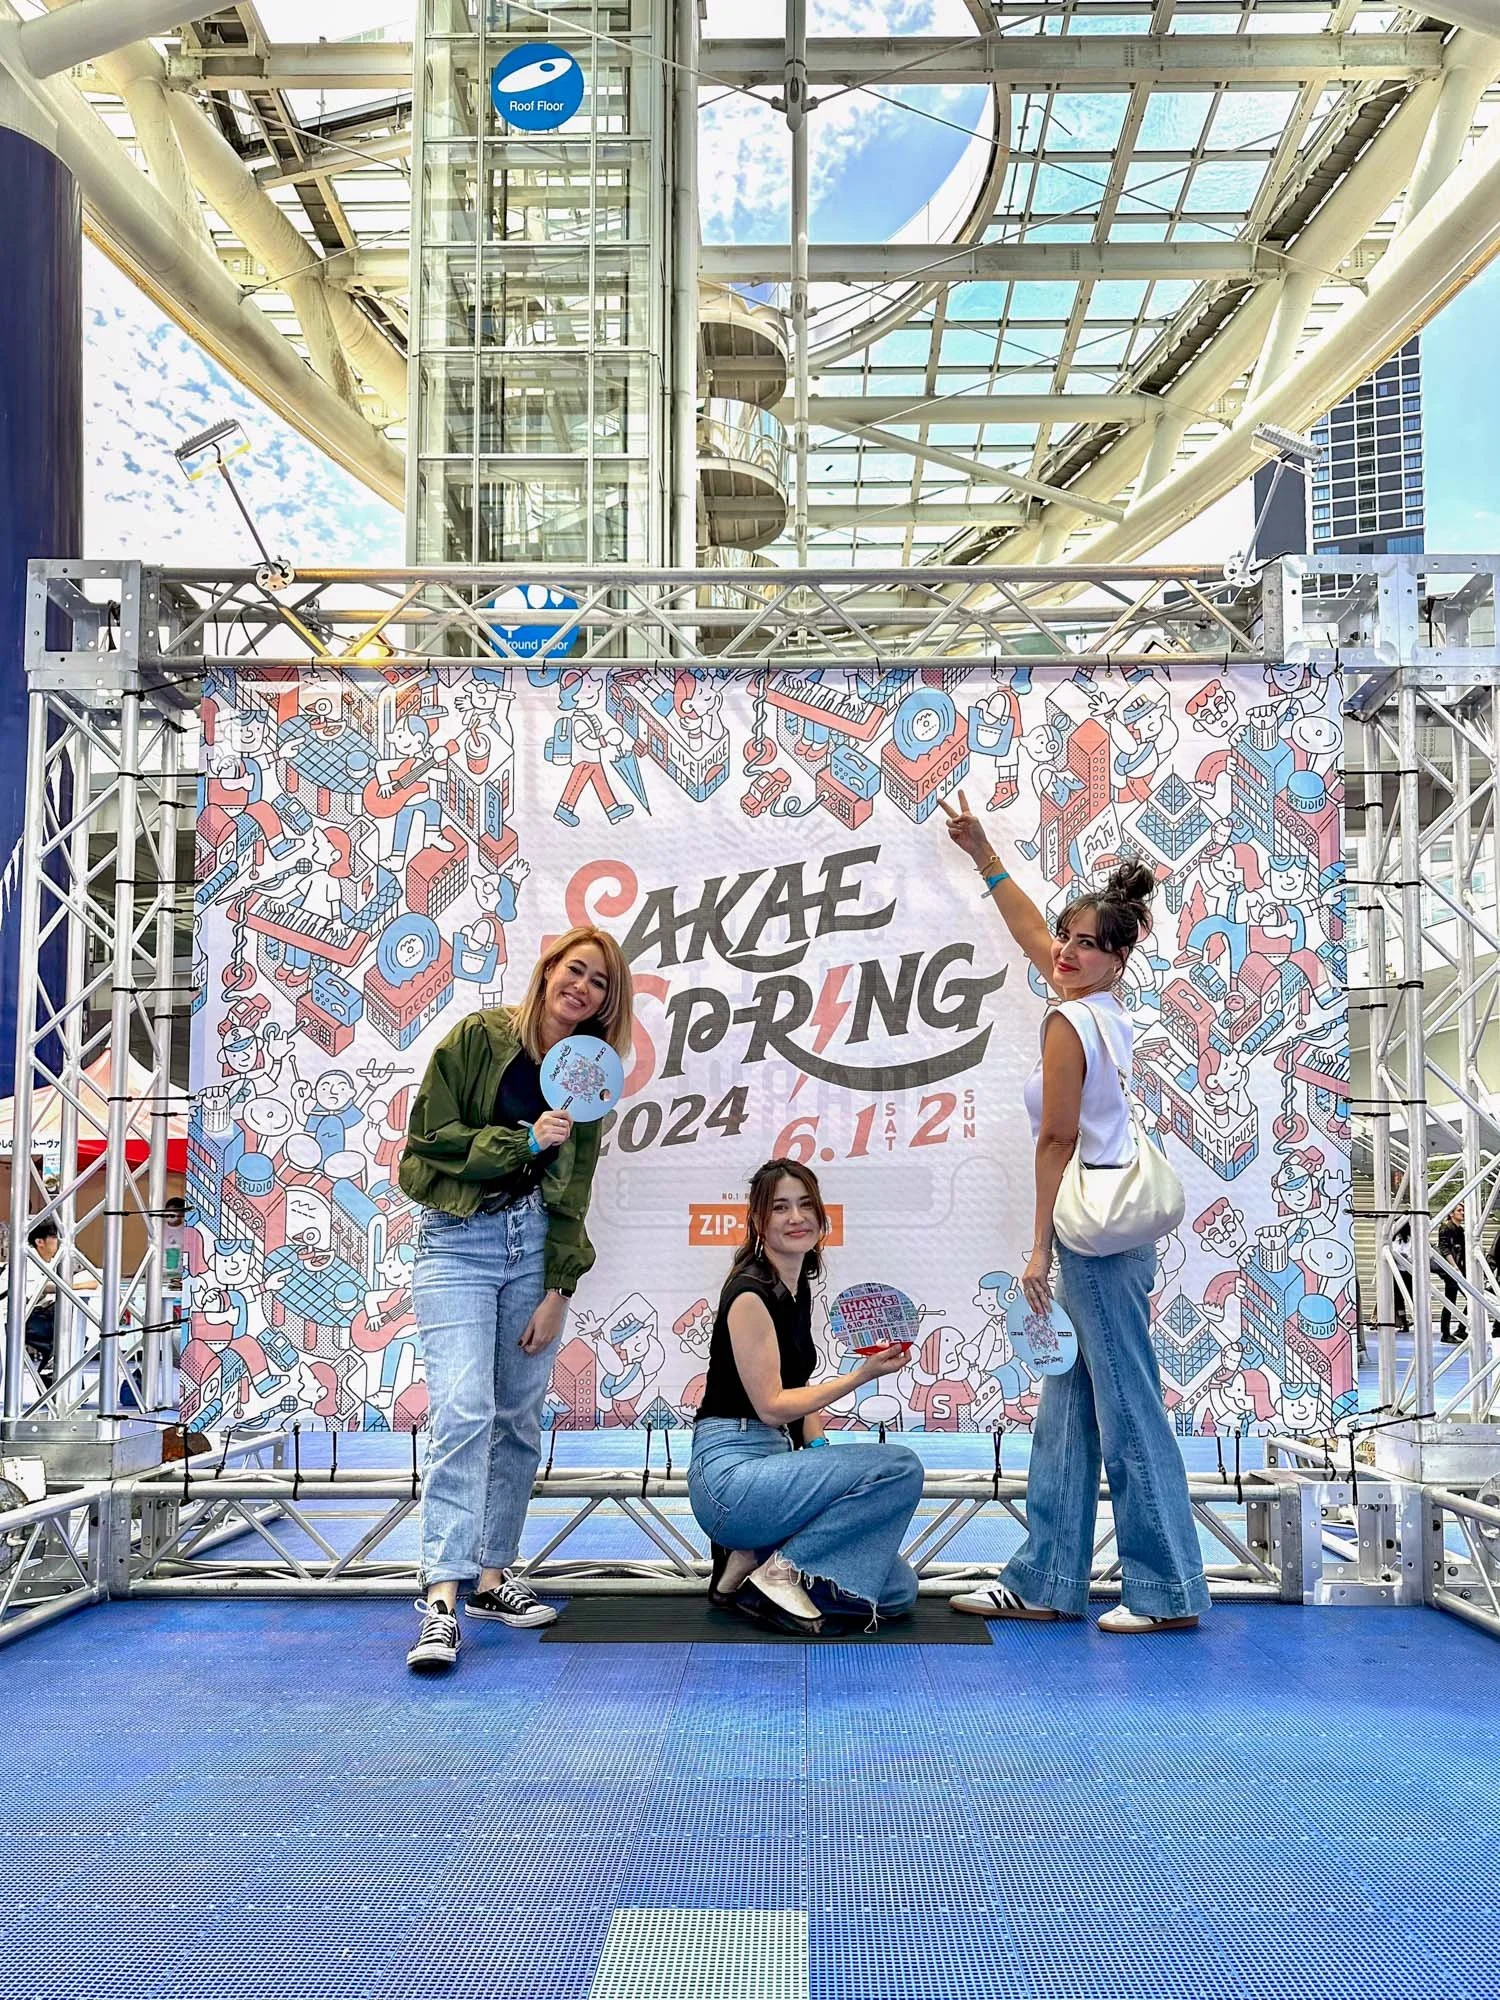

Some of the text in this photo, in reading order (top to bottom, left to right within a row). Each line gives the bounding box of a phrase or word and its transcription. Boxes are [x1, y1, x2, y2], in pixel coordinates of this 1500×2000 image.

[509, 100, 564, 111] Roof Floor
[503, 639, 568, 650] round Foor
[670, 742, 695, 778] LIVE
[922, 744, 966, 795] RECORD
[488, 791, 497, 834] RADIO
[1048, 826, 1057, 875] MUSIC
[541, 844, 897, 973] SAKAE
[404, 970, 450, 1021] RECORD
[231, 1028, 242, 1041] S
[1234, 1010, 1259, 1037] CAFE
[772, 1089, 976, 1166] 6.1 SAT 2 SUN
[1195, 1118, 1223, 1156] LIVE
[1285, 1166, 1296, 1180] S
[722, 1192, 739, 1201] NO.1
[841, 1295, 892, 1313] THANKS
[844, 1307, 883, 1322] ZIPPIE
[932, 1393, 951, 1420] S
